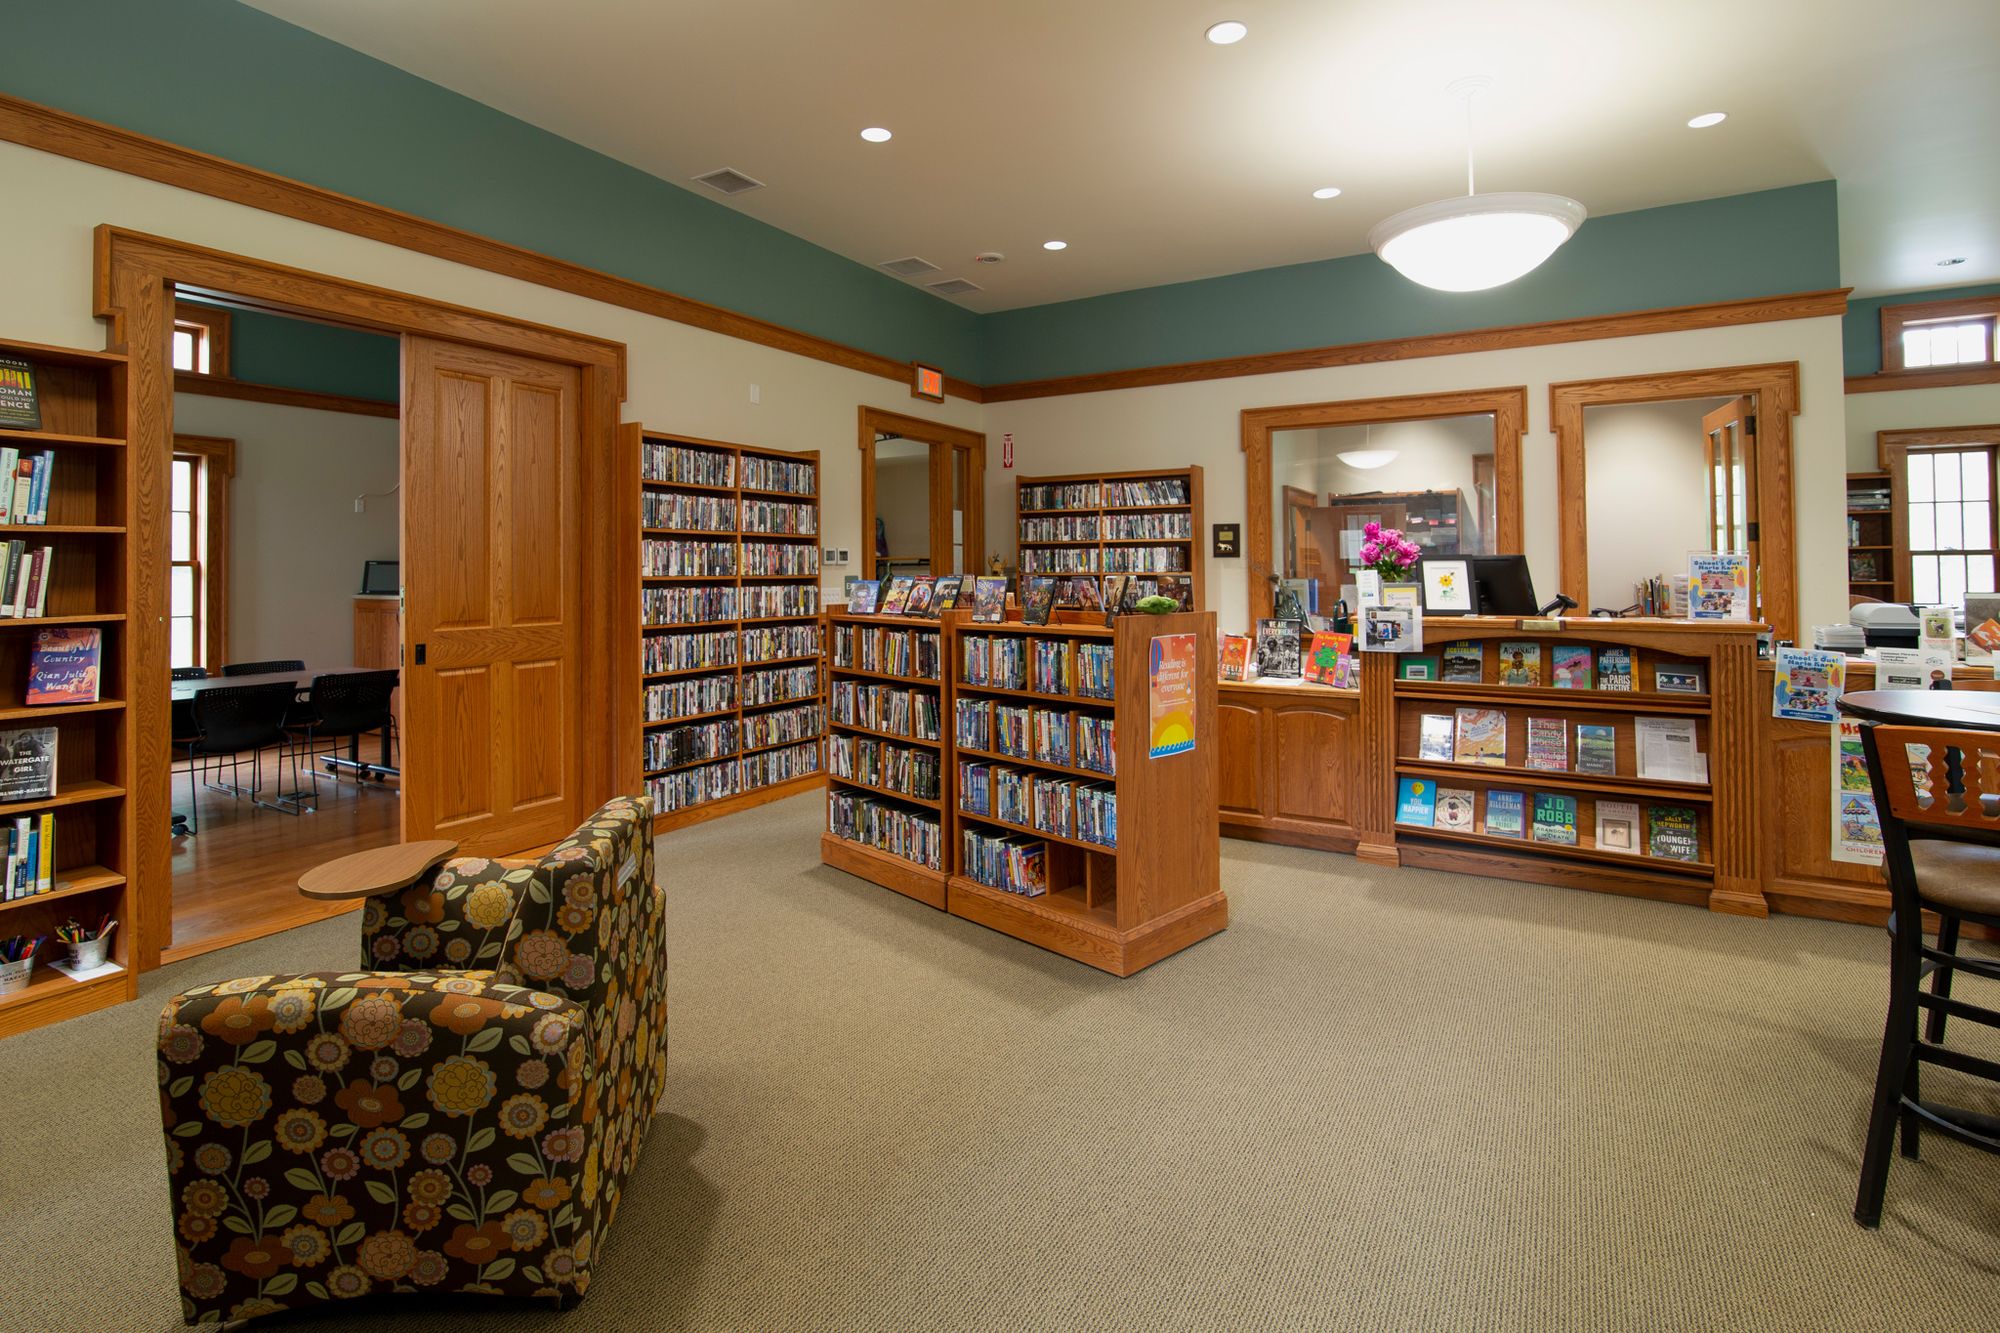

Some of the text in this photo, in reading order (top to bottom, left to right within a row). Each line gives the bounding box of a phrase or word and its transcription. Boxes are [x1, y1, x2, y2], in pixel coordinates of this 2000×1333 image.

[0, 387, 32, 397] OMAN
[1605, 649, 1623, 657] JAMES
[43, 655, 86, 664] Country
[1599, 656, 1630, 664] PATTERSON
[1222, 664, 1243, 673] FELIX
[1609, 674, 1630, 685] PARIS
[0, 755, 50, 766] WATERGATE
[14, 765, 33, 773] GIRL
[1537, 808, 1574, 824] ROBB
[1670, 844, 1690, 855] WIFE
